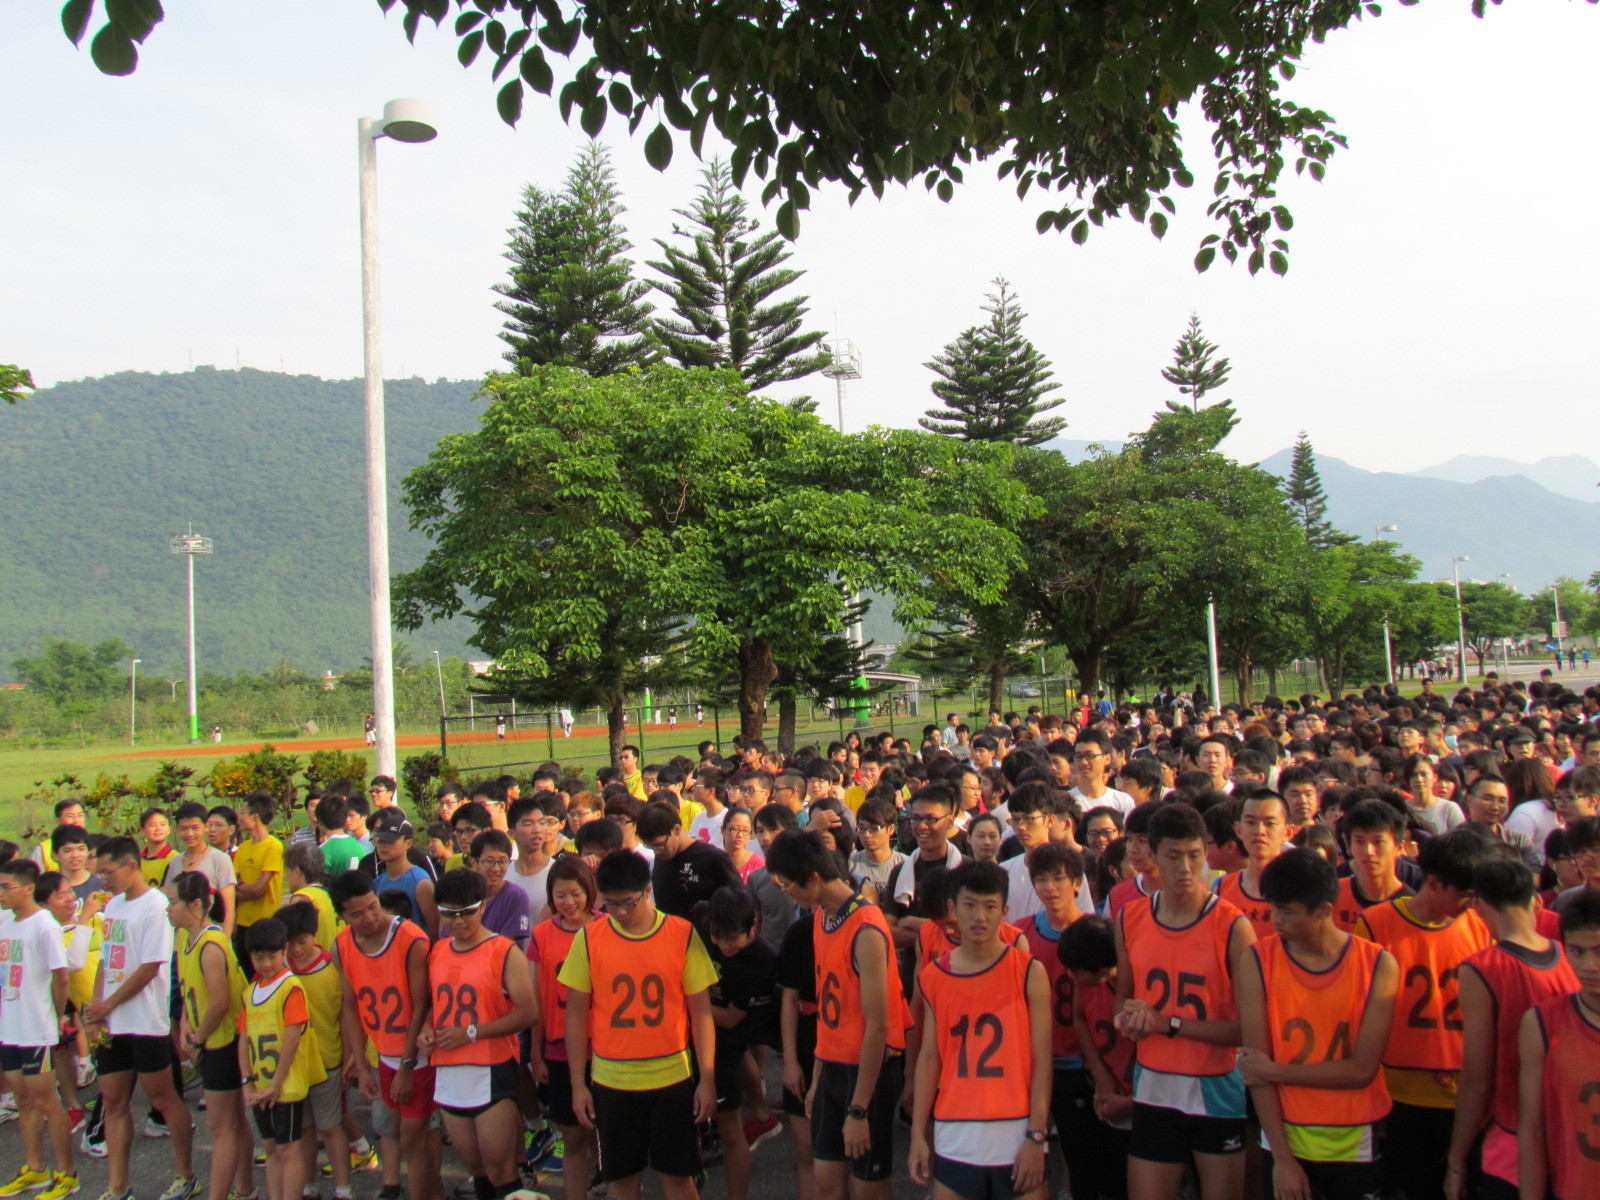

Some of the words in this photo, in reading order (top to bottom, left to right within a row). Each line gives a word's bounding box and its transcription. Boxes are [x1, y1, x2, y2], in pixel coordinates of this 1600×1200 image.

[358, 986, 408, 1034] 32
[436, 983, 478, 1029] 28
[610, 973, 664, 1028] 29
[816, 964, 842, 1030] 6
[1146, 968, 1207, 1021] 25
[1405, 965, 1464, 1031] 22
[950, 1012, 1004, 1078] 12
[1282, 1018, 1351, 1065] 24
